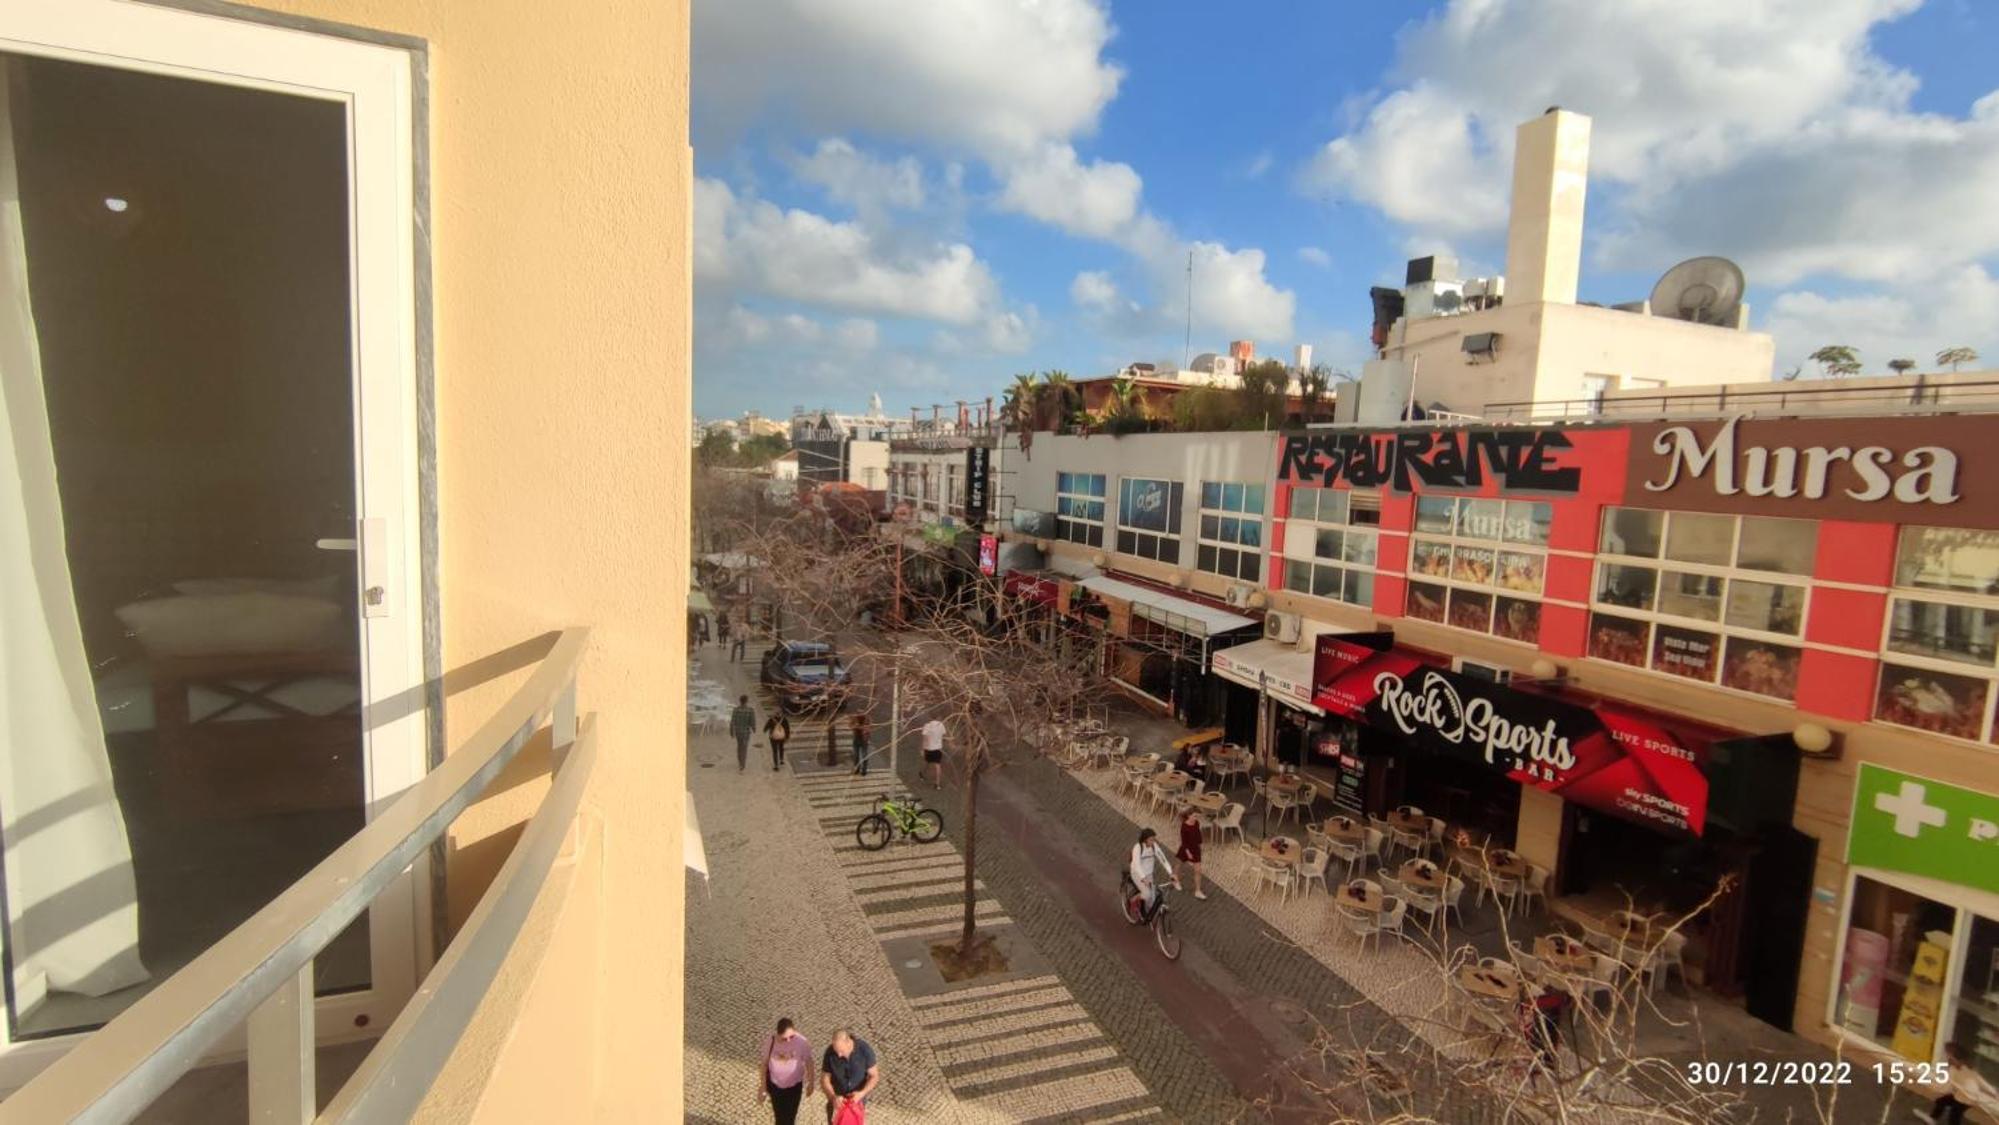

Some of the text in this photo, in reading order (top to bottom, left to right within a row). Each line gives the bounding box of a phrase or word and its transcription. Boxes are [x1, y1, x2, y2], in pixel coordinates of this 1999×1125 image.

[1278, 430, 1581, 492] RESTAURANTE
[1644, 411, 1961, 504] Mursa
[1321, 646, 1360, 664] LIVE MUSIC
[1373, 671, 1576, 770] Rock Sports
[1612, 730, 1696, 762] LIVE SPORTS
[1514, 757, 1555, 782] BAR
[1642, 793, 1690, 817] SPORTS
